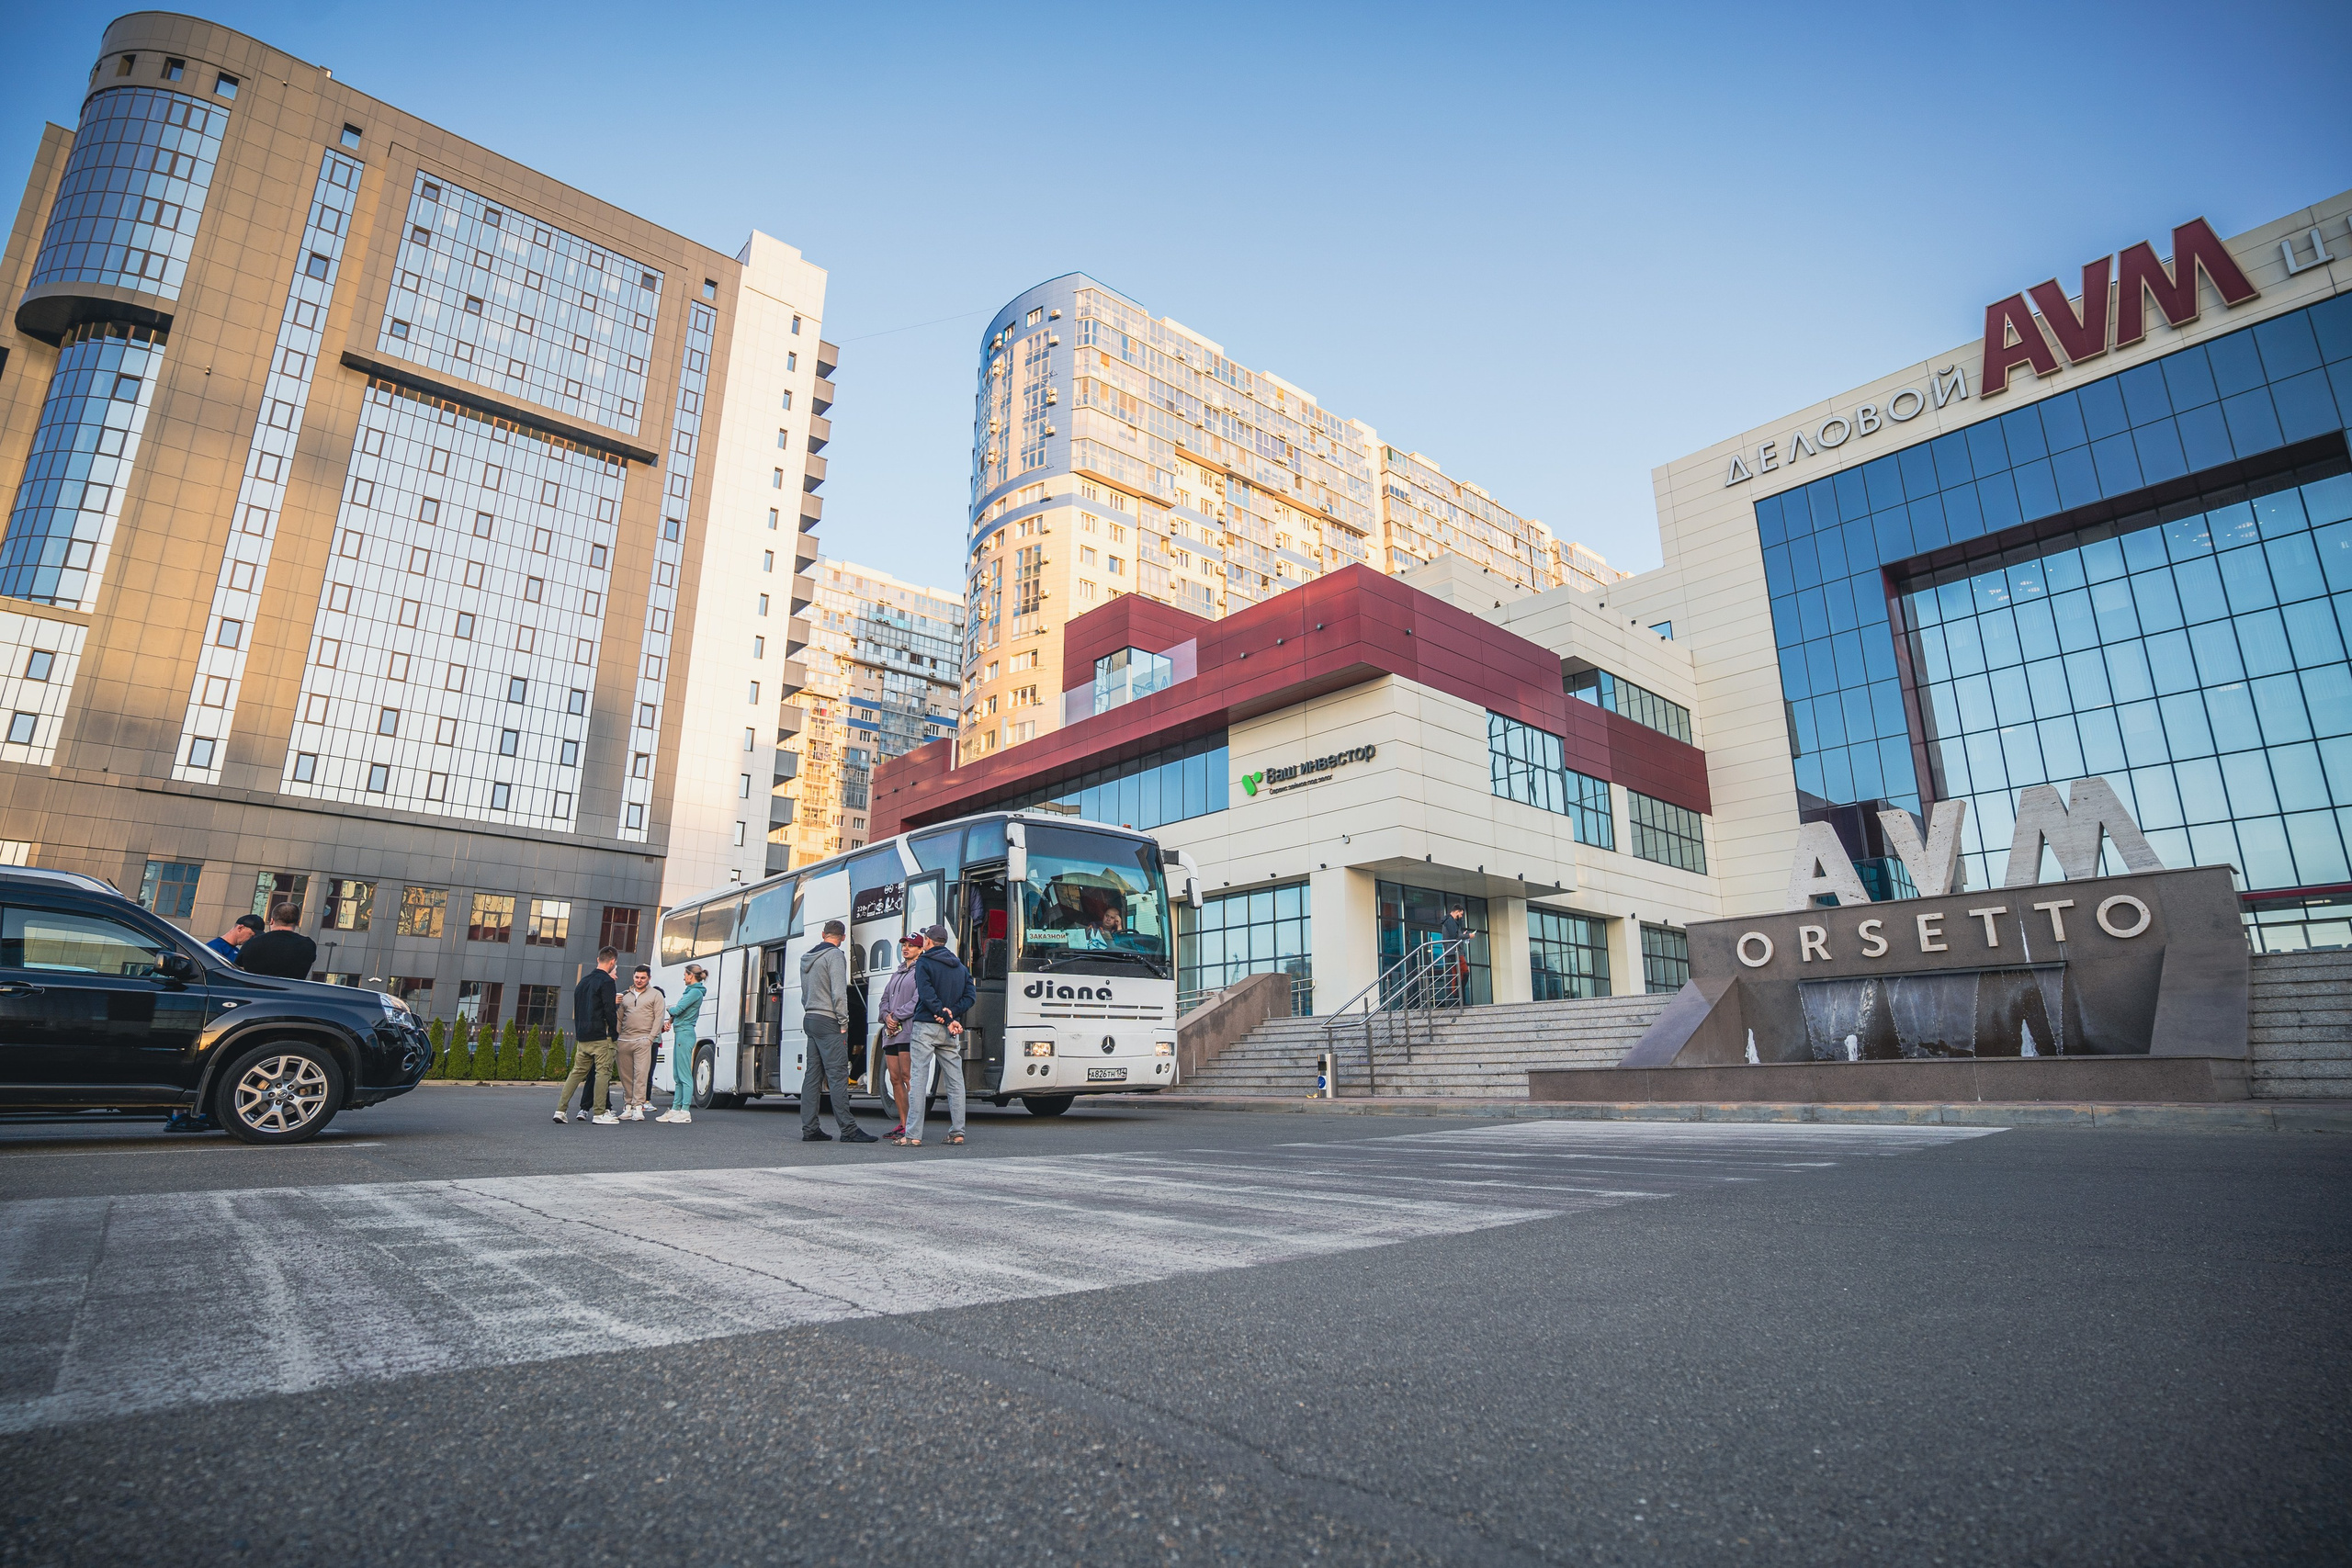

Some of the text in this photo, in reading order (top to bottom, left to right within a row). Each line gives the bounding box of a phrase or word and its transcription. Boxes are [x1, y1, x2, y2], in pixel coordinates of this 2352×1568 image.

[1725, 213, 2352, 488] ДЕЛОВОЙ AVM Ц
[1266, 743, 1376, 784] Ваш инвестор
[1785, 776, 2165, 911] AVM
[1736, 893, 2153, 969] ORSETTO
[1023, 979, 1113, 1001] diana
